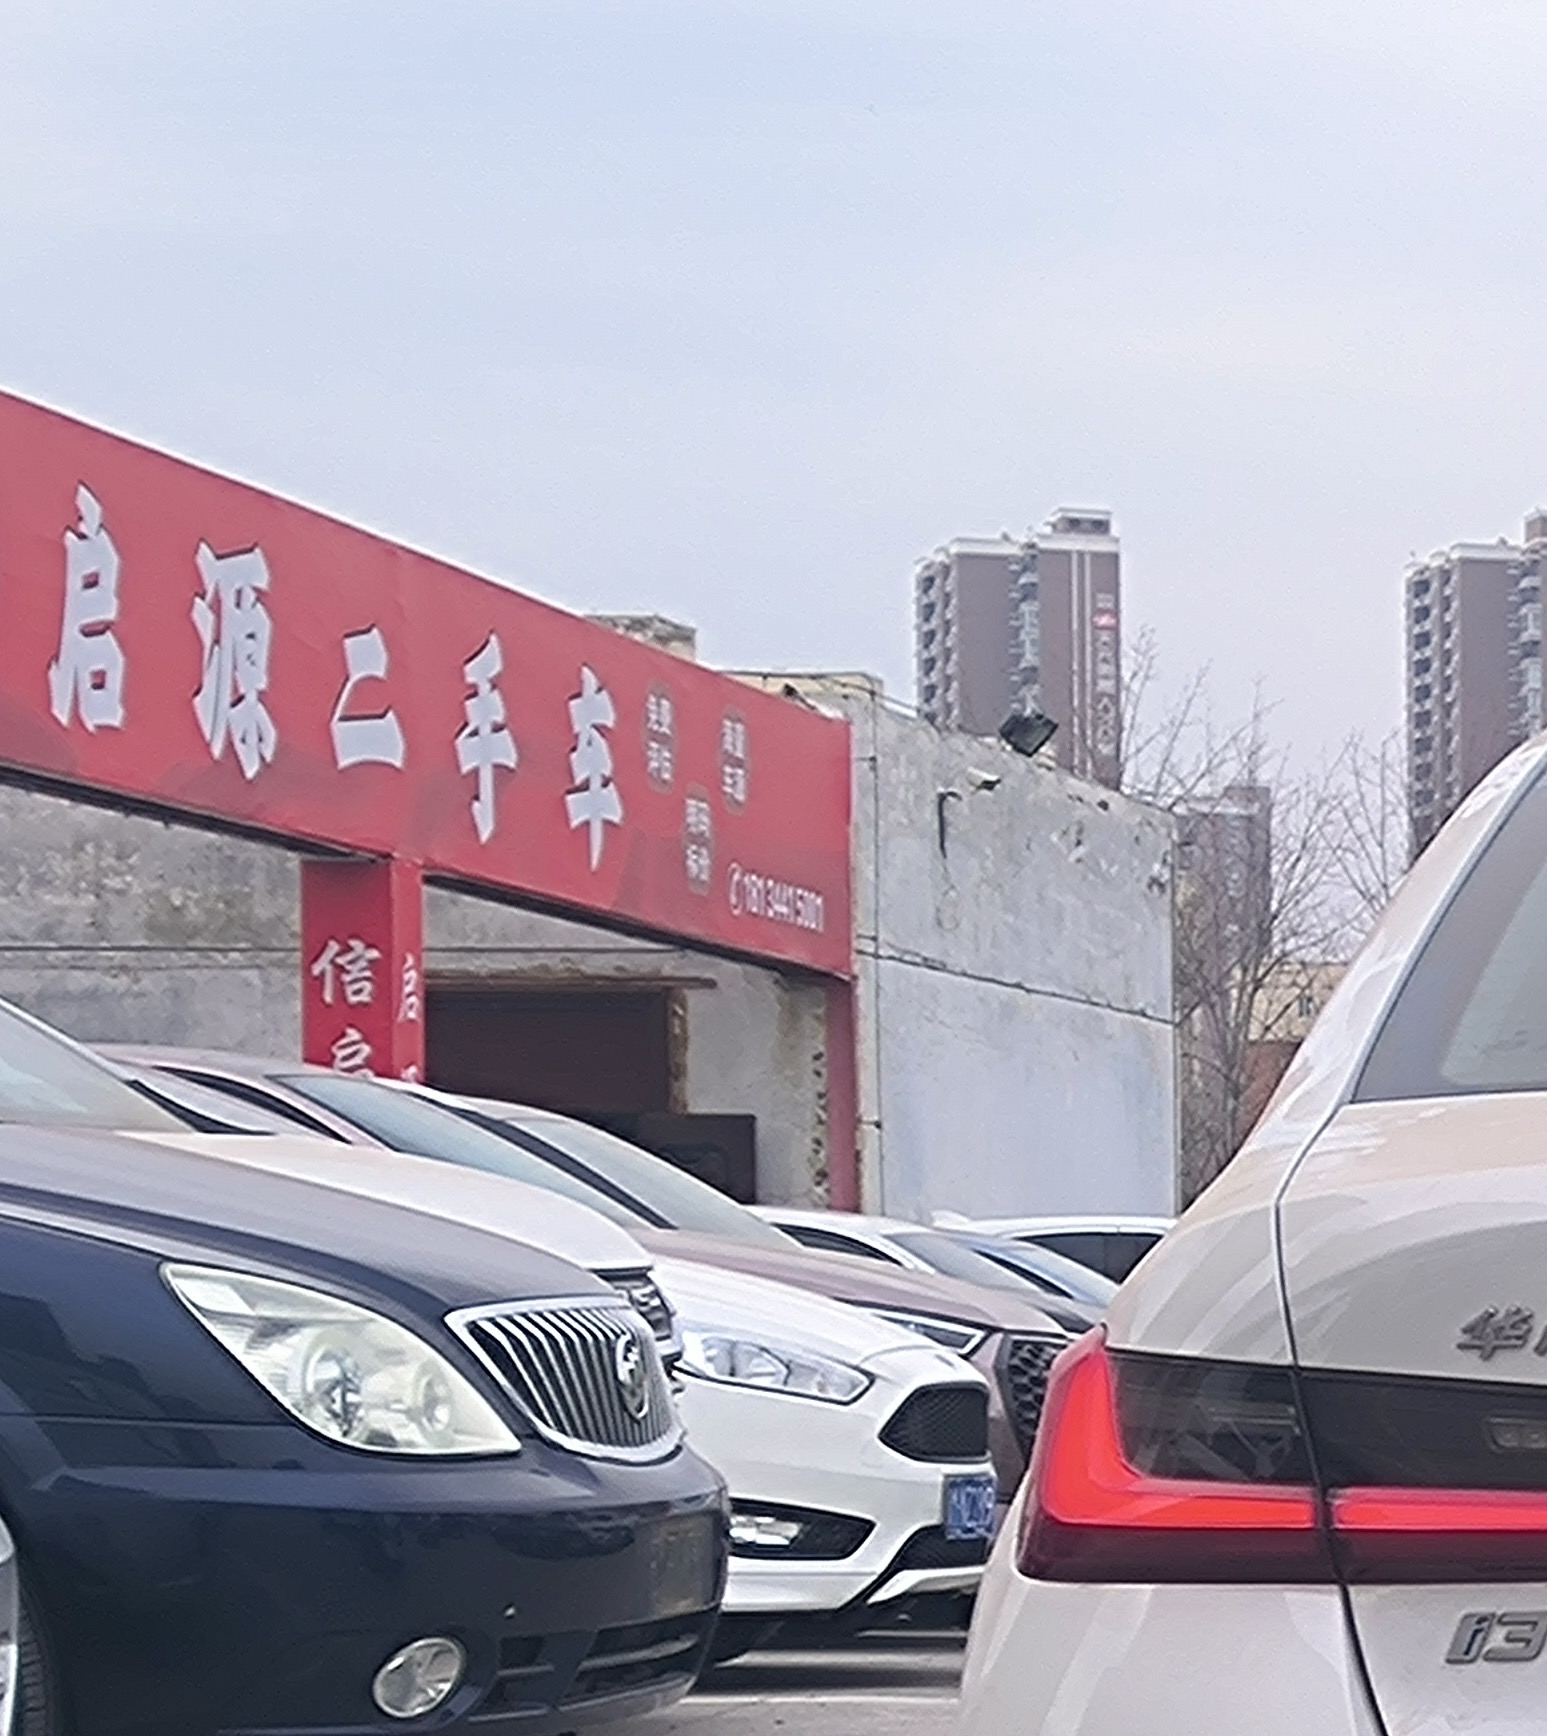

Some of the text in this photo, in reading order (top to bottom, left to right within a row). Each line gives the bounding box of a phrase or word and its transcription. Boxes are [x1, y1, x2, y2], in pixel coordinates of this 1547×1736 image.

[48, 481, 624, 872] 启源二手车
